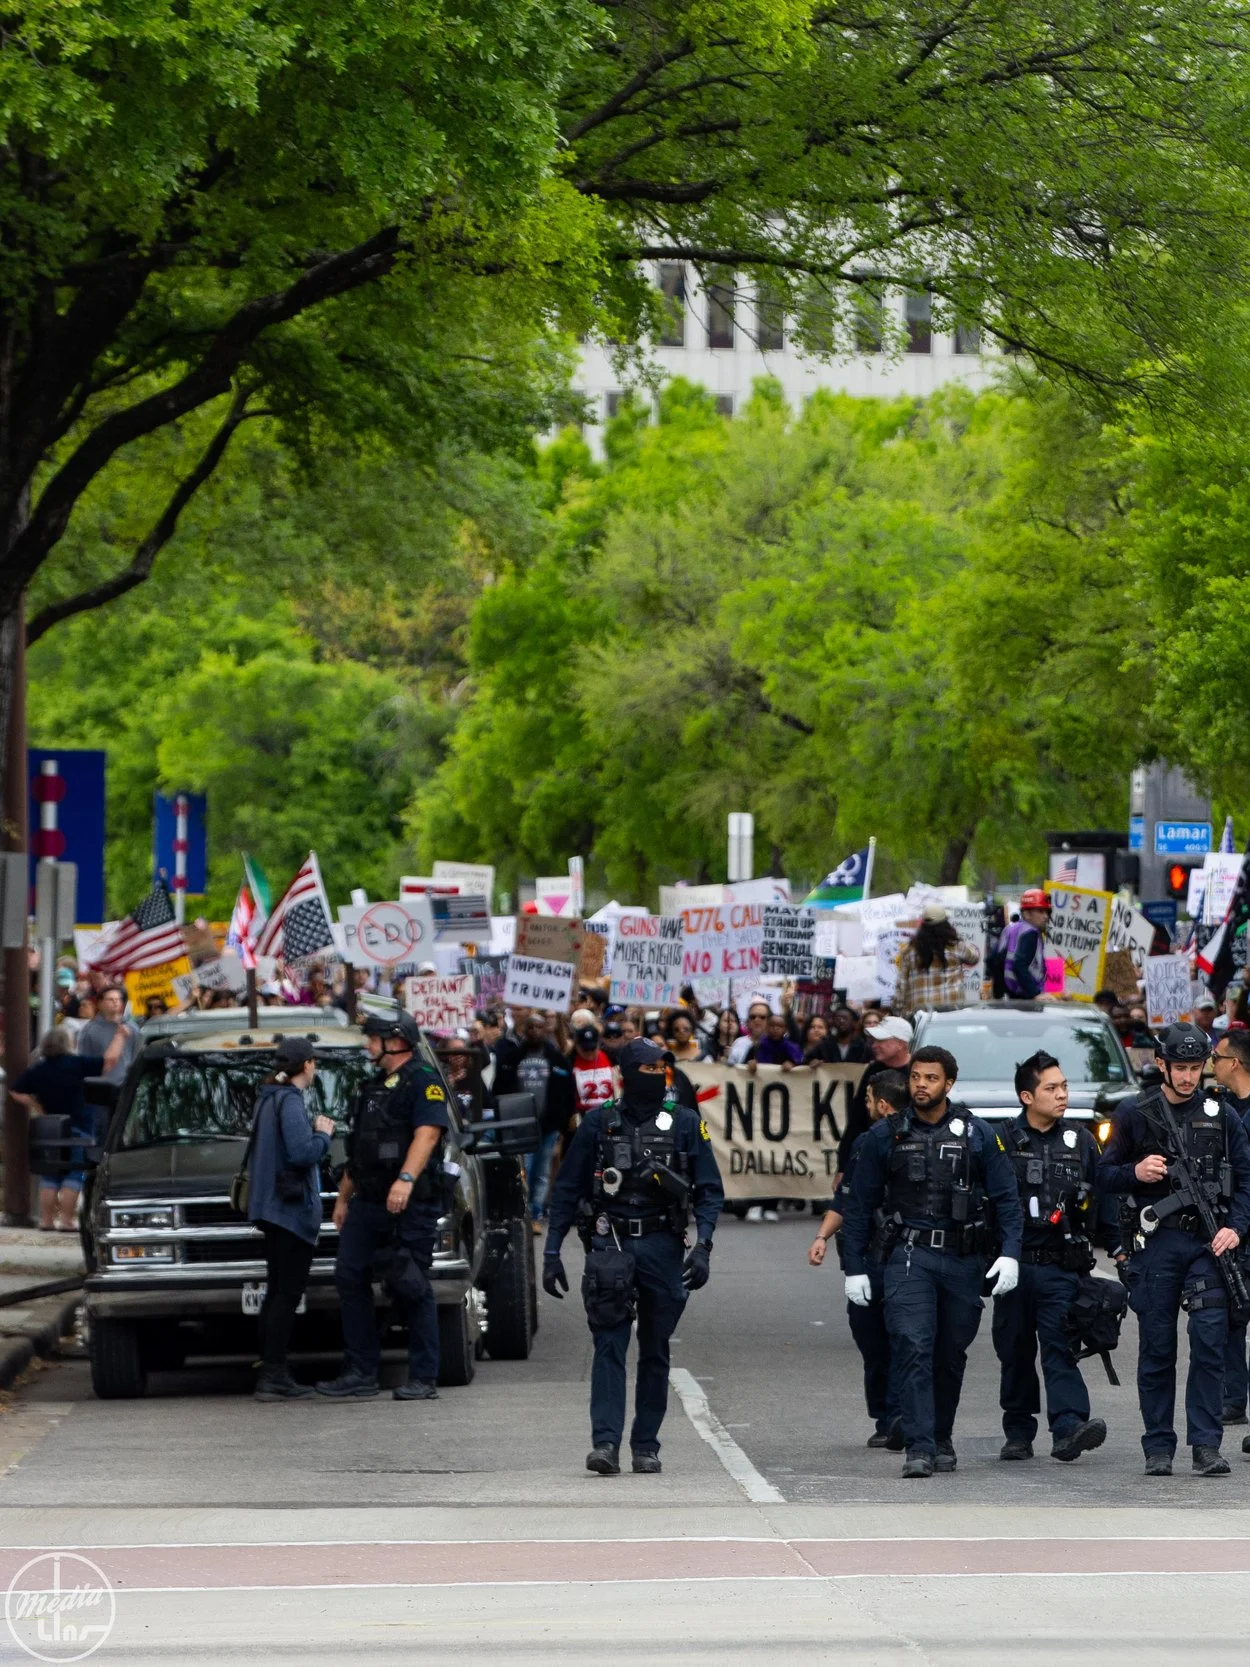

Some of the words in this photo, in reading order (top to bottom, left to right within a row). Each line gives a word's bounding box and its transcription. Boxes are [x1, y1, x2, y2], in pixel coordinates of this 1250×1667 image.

[1158, 825, 1207, 840] Lamar
[680, 907, 725, 934] 1776
[764, 906, 800, 915] MAY
[1114, 900, 1132, 929] NO
[619, 915, 658, 937] GUNS
[659, 916, 684, 940] HAVE
[763, 916, 798, 928] STAND
[800, 917, 816, 929] UP
[1048, 914, 1065, 928] NO
[1066, 914, 1103, 935] KINGS
[344, 918, 424, 948] PEDO
[763, 928, 776, 938] TO
[778, 928, 815, 940] TRUMP
[1064, 931, 1101, 951] TRUMP
[613, 940, 646, 963] MORE
[647, 941, 684, 967] RIGHTS
[761, 941, 813, 957] GENERAL
[511, 958, 572, 979] IMPEACH
[682, 950, 711, 976] NO
[721, 945, 761, 973] KIN
[627, 963, 668, 981] THAN
[411, 976, 468, 995] DEFIANT
[511, 981, 566, 1001] TRUMP
[612, 981, 652, 1001] TRANS
[414, 1007, 468, 1027] DEATH
[583, 1082, 613, 1098] 23
[724, 1080, 790, 1142] NO
[812, 1080, 856, 1142] KI
[730, 1149, 814, 1179] DALLAS,
[822, 1148, 838, 1176] T
